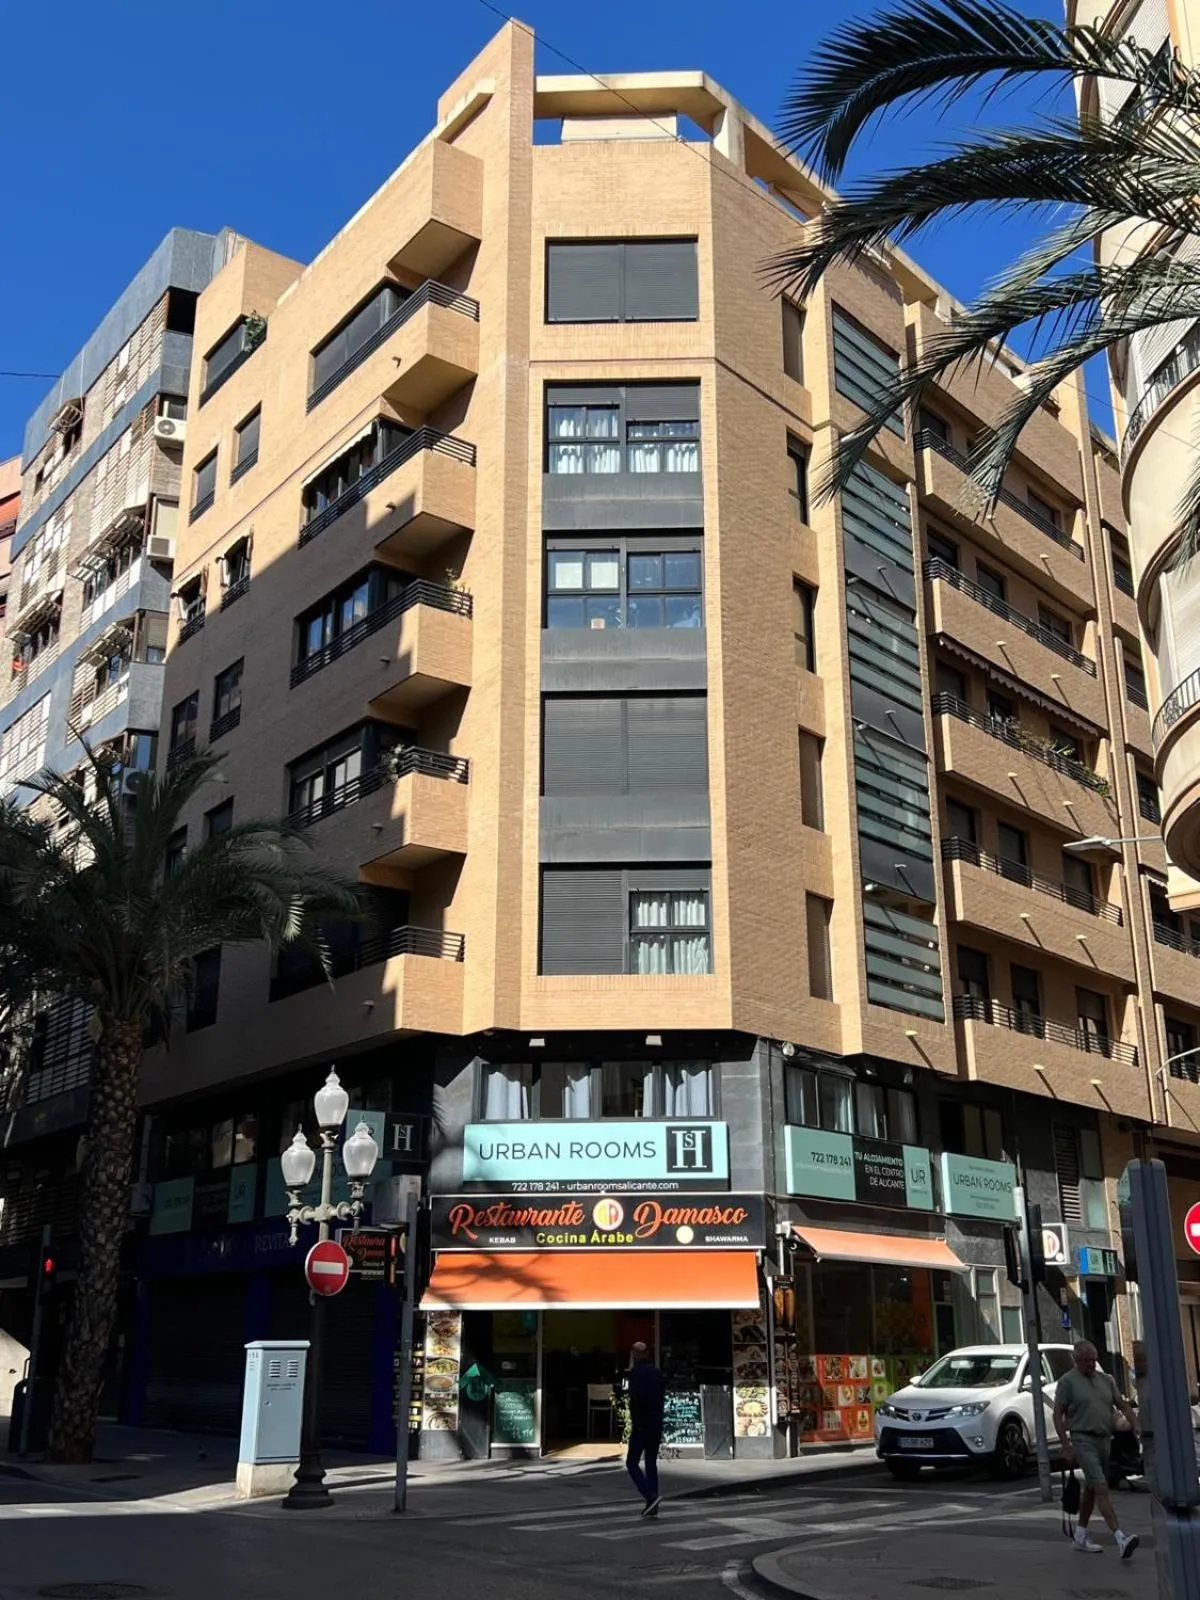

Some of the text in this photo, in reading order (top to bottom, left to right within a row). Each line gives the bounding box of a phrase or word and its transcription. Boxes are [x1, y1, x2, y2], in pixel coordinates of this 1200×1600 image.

[479, 1141, 656, 1161] URBAN ROOMS
[811, 1151, 852, 1167] 722 178 241
[911, 1168, 926, 1184] UR
[953, 1173, 1012, 1193] URBAN ROOMS
[512, 1182, 527, 1191] 722
[530, 1182, 543, 1191] 178
[545, 1182, 560, 1191] 241
[567, 1181, 679, 1191] urbanroomsalicante.com
[879, 1178, 905, 1190] ALICANTE
[449, 1200, 748, 1240] Restaurante Damasco
[489, 1236, 517, 1244] KEBAB
[536, 1229, 634, 1244] Cocina Árabe
[704, 1235, 749, 1243] SHAWARMA
